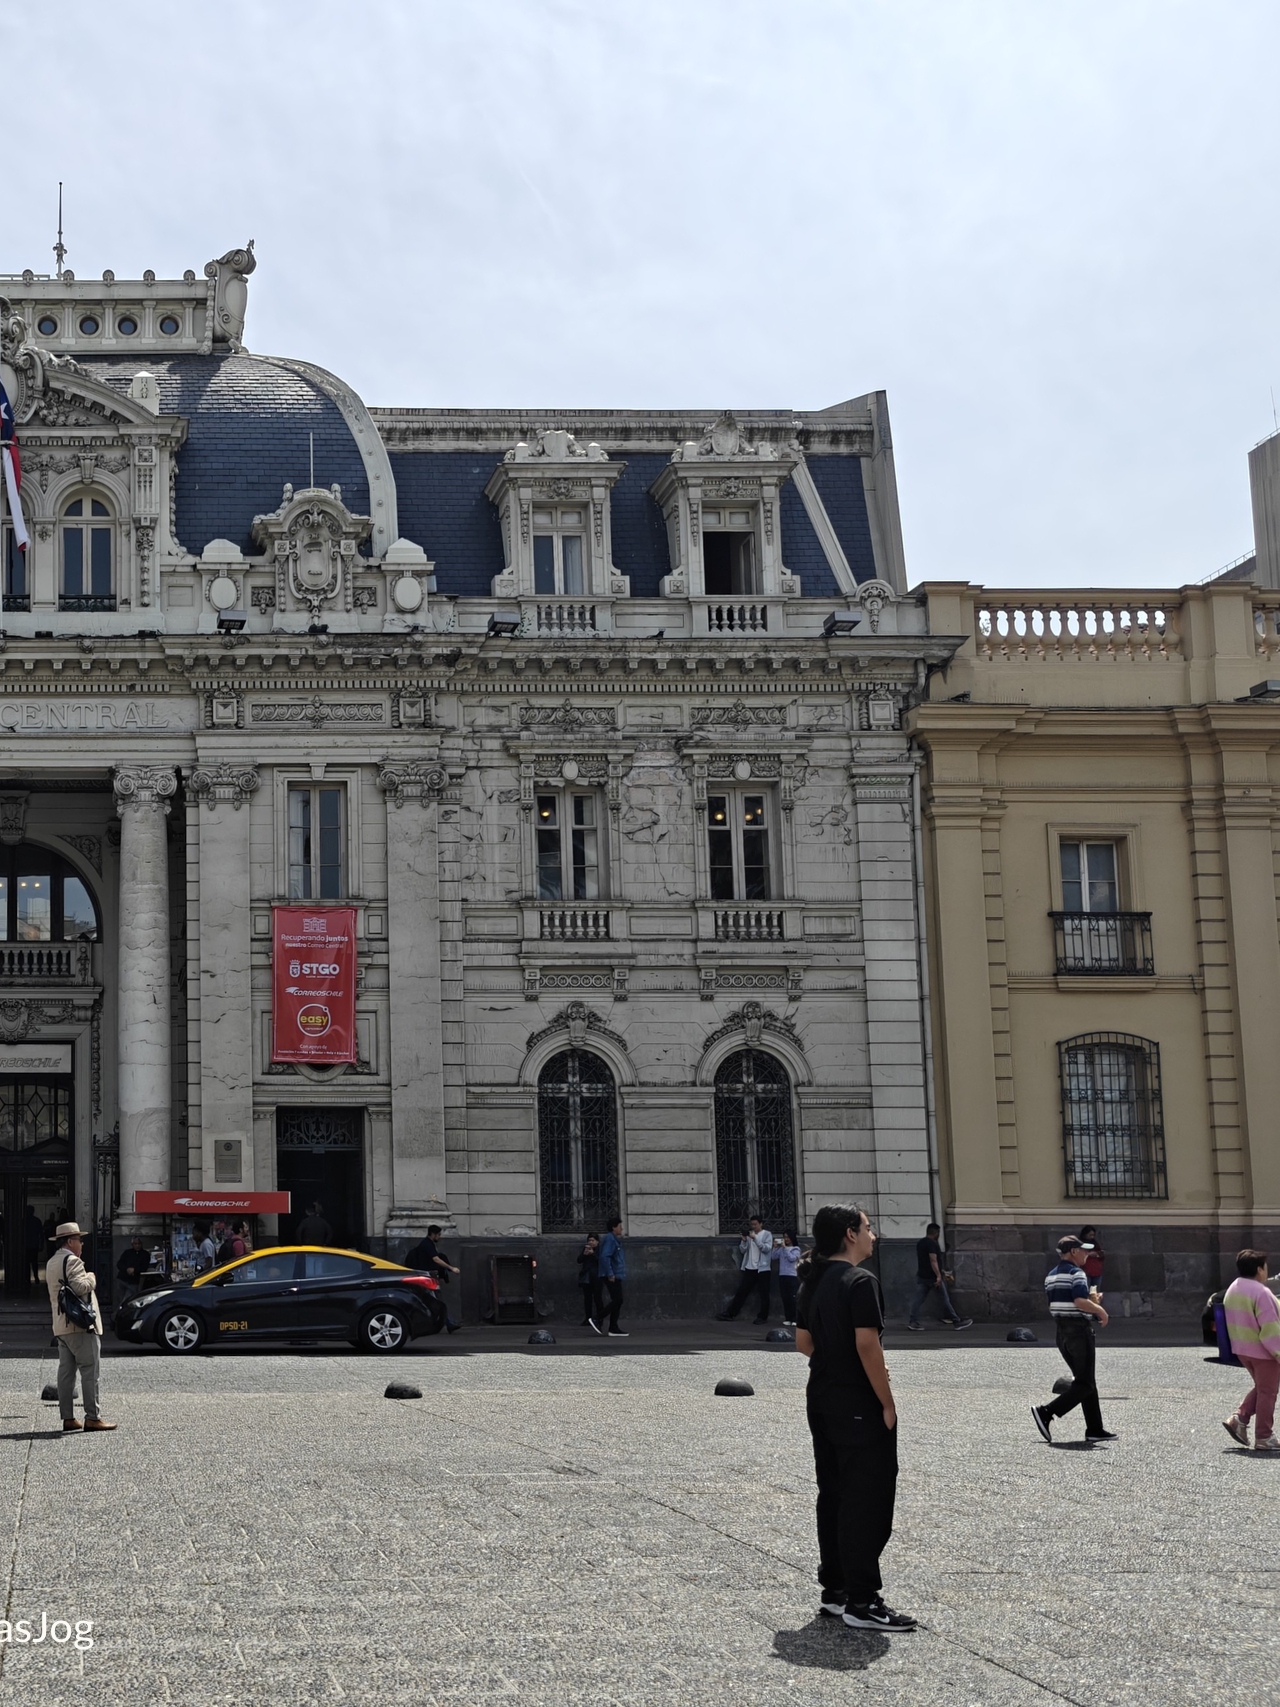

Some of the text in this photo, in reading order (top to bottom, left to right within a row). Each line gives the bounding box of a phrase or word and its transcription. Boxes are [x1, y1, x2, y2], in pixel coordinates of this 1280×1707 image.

[281, 934, 349, 943] Recuperando juntos
[301, 963, 340, 975] STGO
[300, 1015, 328, 1026] easy
